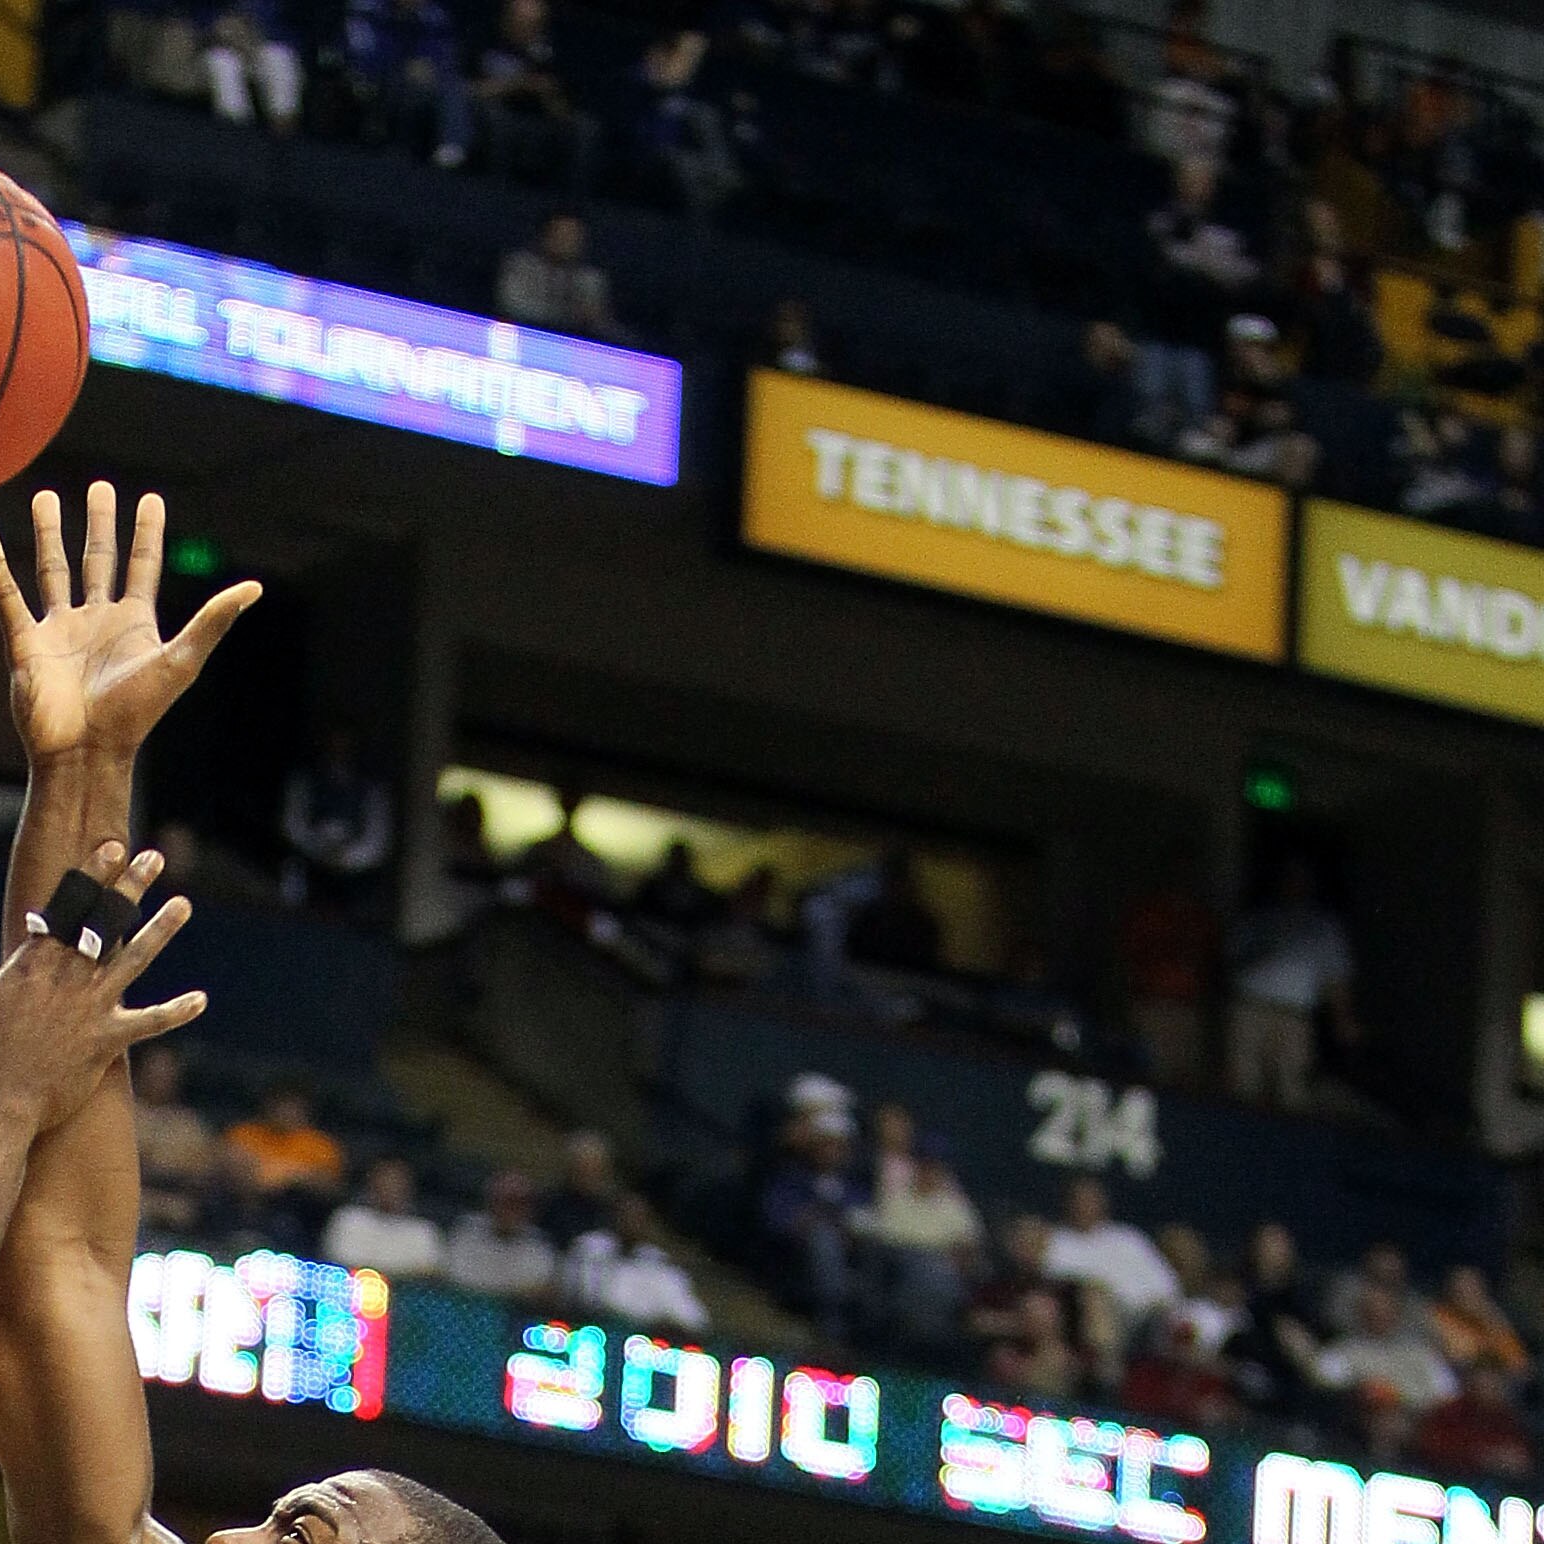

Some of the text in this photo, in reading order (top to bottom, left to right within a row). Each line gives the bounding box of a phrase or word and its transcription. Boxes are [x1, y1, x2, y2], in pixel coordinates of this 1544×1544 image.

[215, 298, 650, 446] TOURNAMENT
[804, 427, 1228, 588] TENNESSEE
[1026, 1068, 1162, 1180] 214
[504, 1320, 880, 1484] 2010
